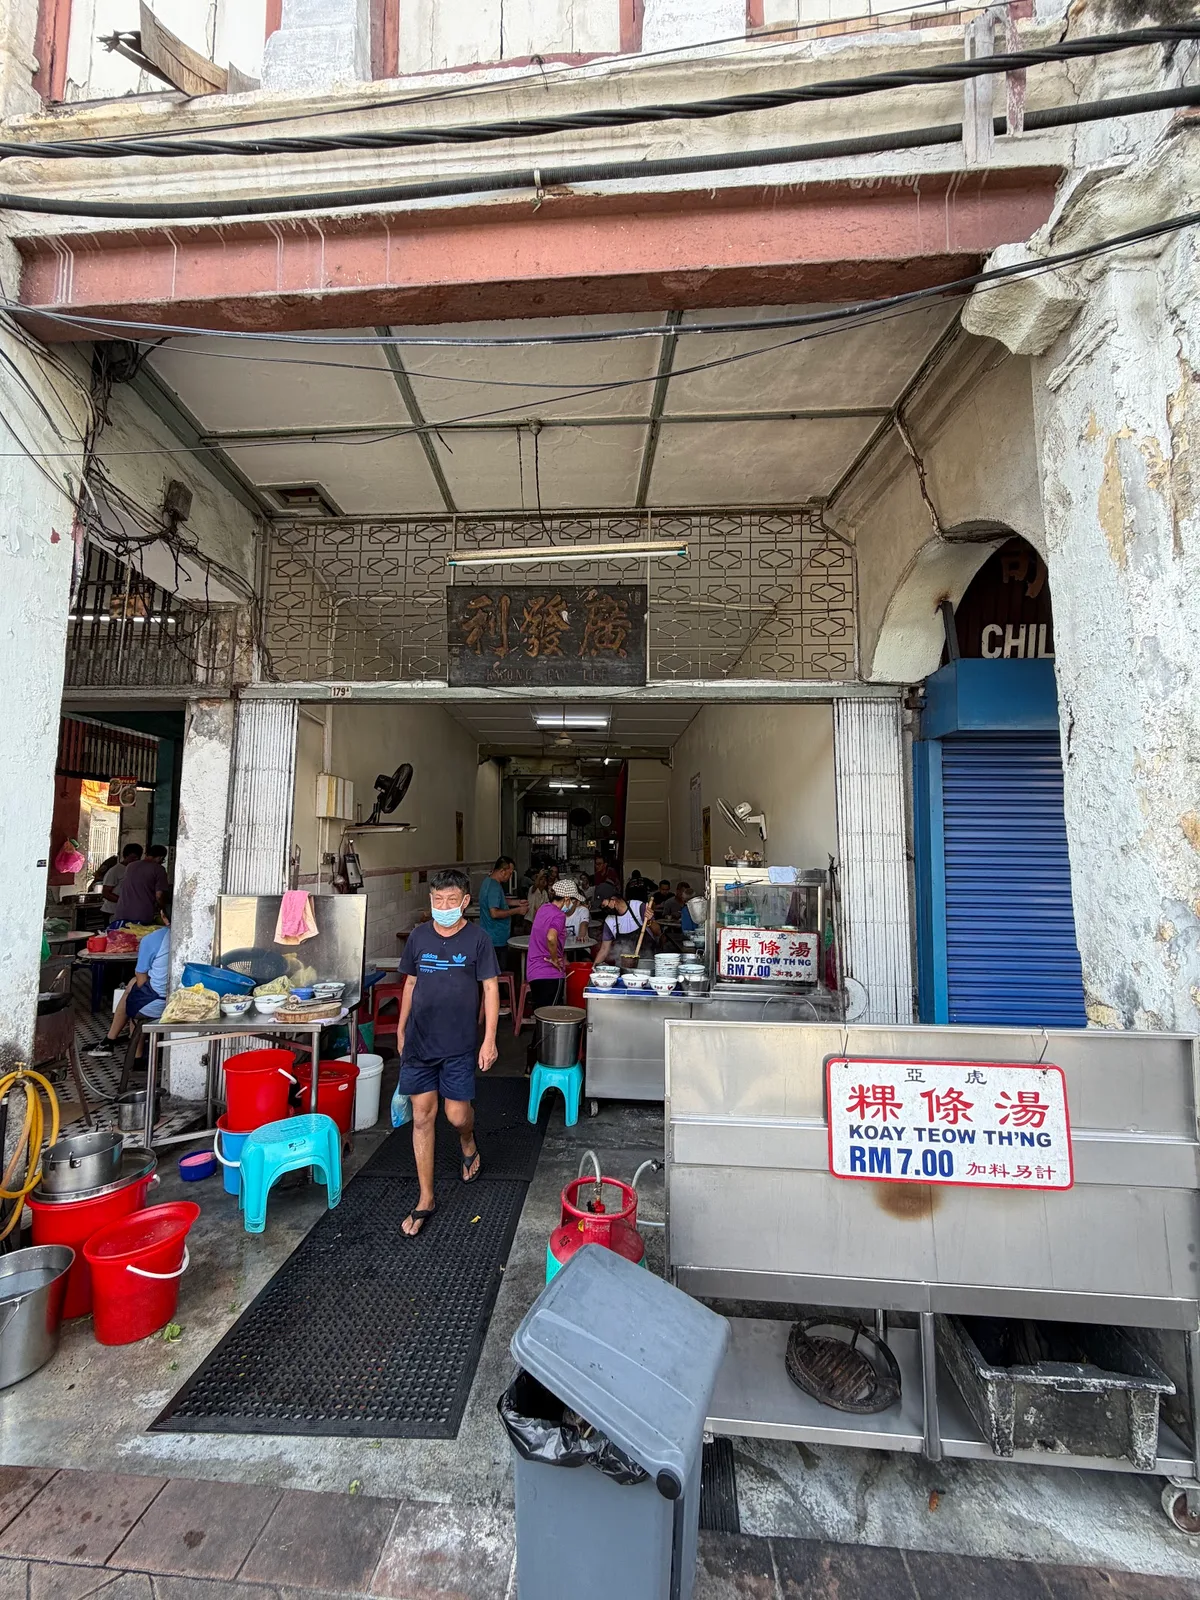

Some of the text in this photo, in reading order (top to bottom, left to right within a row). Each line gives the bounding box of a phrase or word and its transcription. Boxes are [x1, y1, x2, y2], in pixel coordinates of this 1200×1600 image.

[727, 939, 811, 957] 粿條湯
[903, 1068, 988, 1085] 亞虎
[845, 1083, 1051, 1128] 粿條湯
[849, 1124, 1052, 1148] KOAY TEOW TH'NG
[849, 1145, 954, 1178] RM7.00
[965, 1162, 1057, 1181] 加料另計
